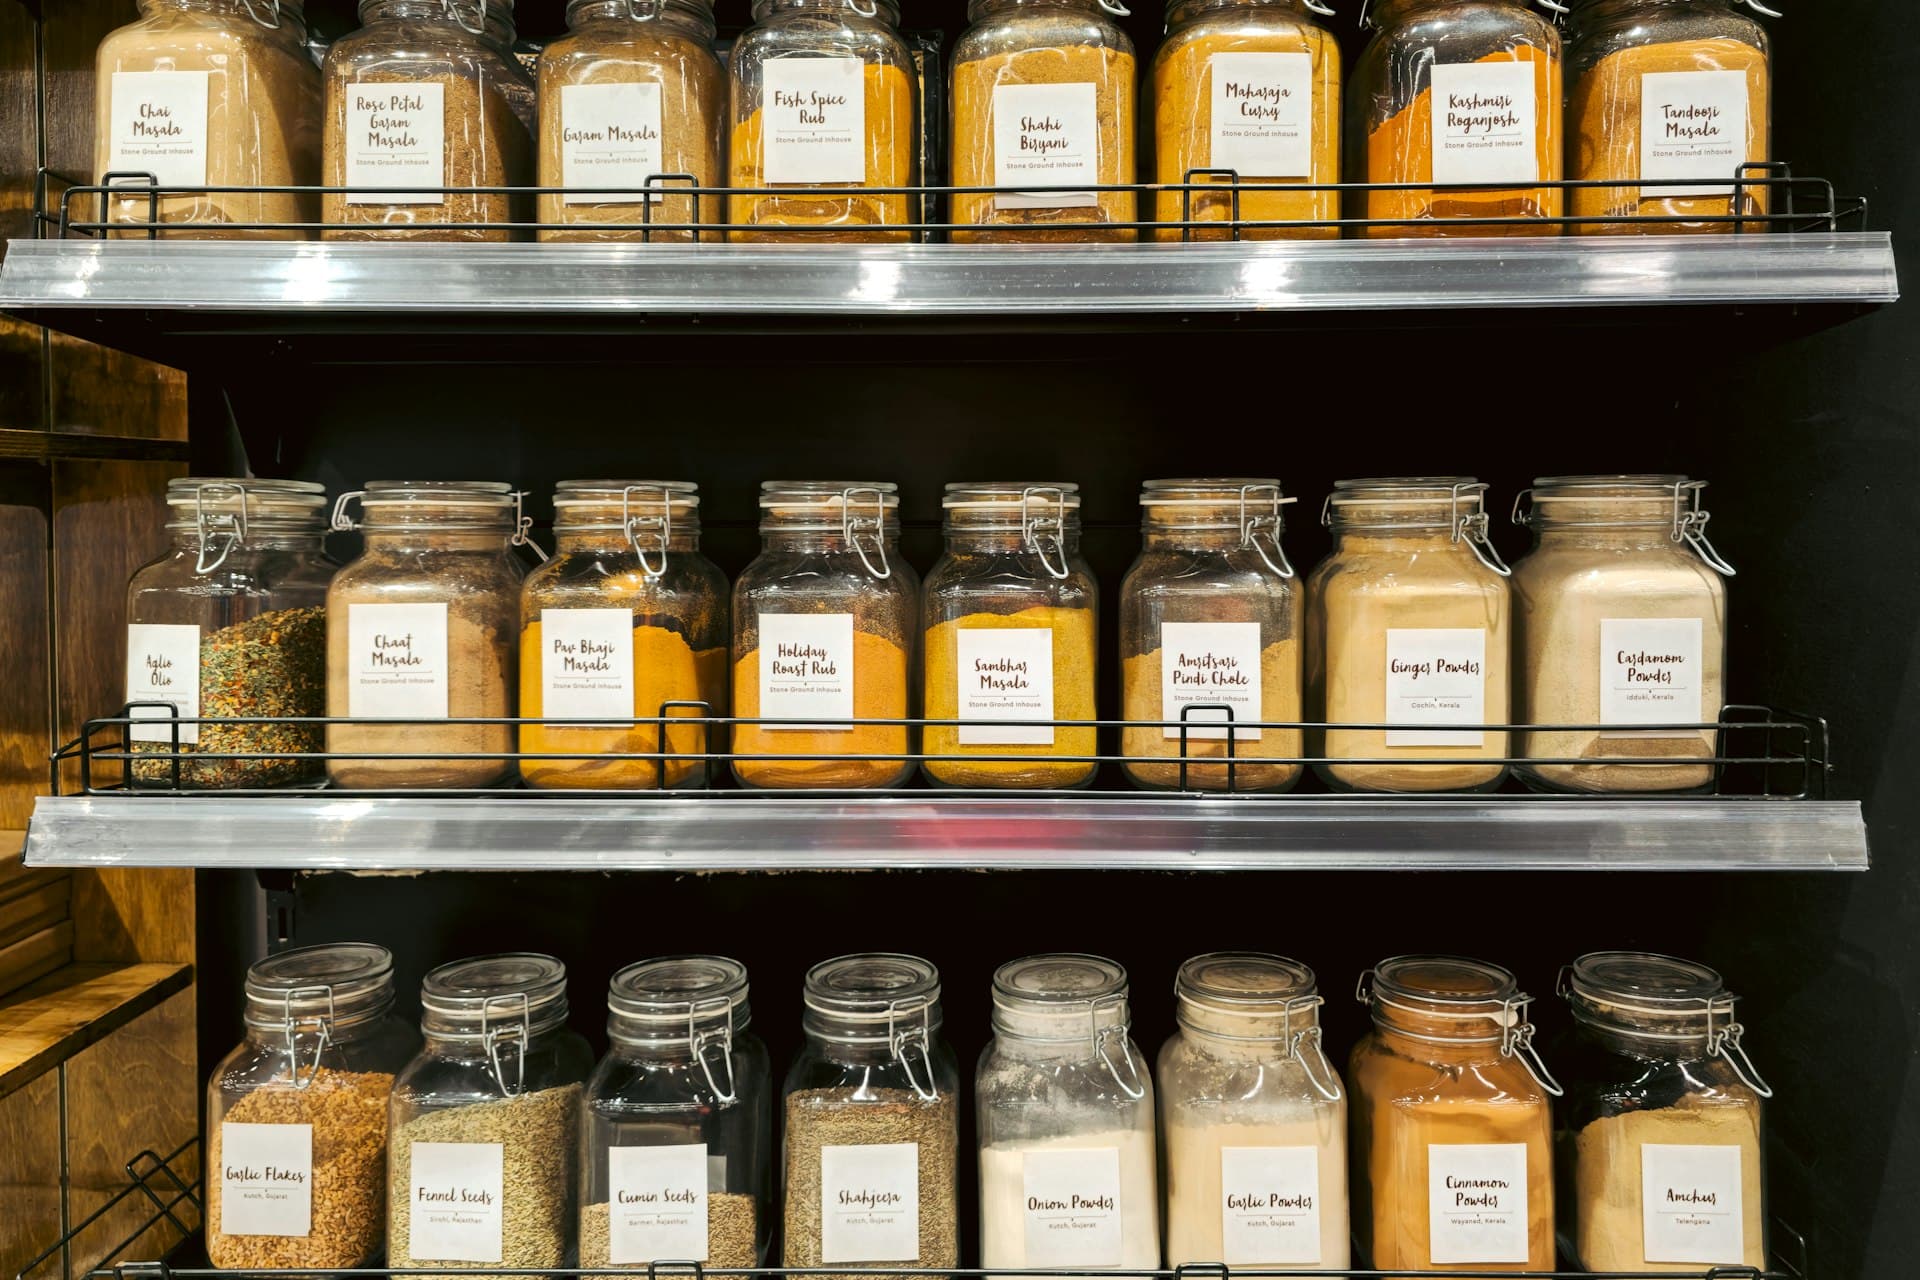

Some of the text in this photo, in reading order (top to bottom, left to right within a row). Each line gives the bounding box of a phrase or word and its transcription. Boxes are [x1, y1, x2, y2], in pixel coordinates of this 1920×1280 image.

[1225, 82, 1291, 104] Maharaja
[1449, 94, 1512, 109] Kashmiri
[140, 103, 171, 119] Chai
[357, 96, 424, 112] Rose Petal
[774, 90, 847, 115] Fish Spice
[799, 109, 825, 124] Rub
[1241, 102, 1280, 121] Curry
[1660, 104, 1720, 120] Tandoori
[133, 121, 183, 137] Masala
[370, 114, 411, 130] Garam
[1020, 116, 1062, 132] Shahi
[1447, 111, 1520, 134] Roganjosh
[1666, 121, 1720, 139] Masala
[368, 132, 418, 149] Masala
[563, 124, 658, 144] Garam Masala
[797, 136, 823, 144] Ground
[1020, 135, 1069, 154] Biryani
[1675, 149, 1702, 157] Ground
[374, 633, 413, 650] Chaat
[554, 639, 615, 660] Pav Bhaji
[372, 652, 423, 667] Masala
[778, 643, 827, 662] Holiday
[1617, 651, 1685, 666] Cardamom
[147, 654, 173, 675] Aglio
[564, 657, 611, 672] Masala
[772, 661, 837, 677] Roast Rub
[975, 658, 1028, 675] Sambhar
[1178, 653, 1238, 670] Amritsari
[1391, 659, 1480, 680] Ginger Powder
[151, 672, 172, 686] Olio
[980, 675, 1029, 690] Masala
[1173, 670, 1249, 686] Pindi Chole
[1627, 668, 1672, 685] Powder
[226, 1166, 306, 1184] Garlic Flakes
[1446, 1176, 1509, 1190] Cinnamon
[418, 1187, 494, 1205] Fennel Seeds
[618, 1188, 698, 1205] Cumin Seeds
[838, 1190, 901, 1208] Shahjeera
[1028, 1195, 1114, 1211] Onion Powder
[1227, 1193, 1312, 1210] Garlic Powder
[1456, 1193, 1498, 1208] Powder
[1666, 1188, 1716, 1205] Amchur
